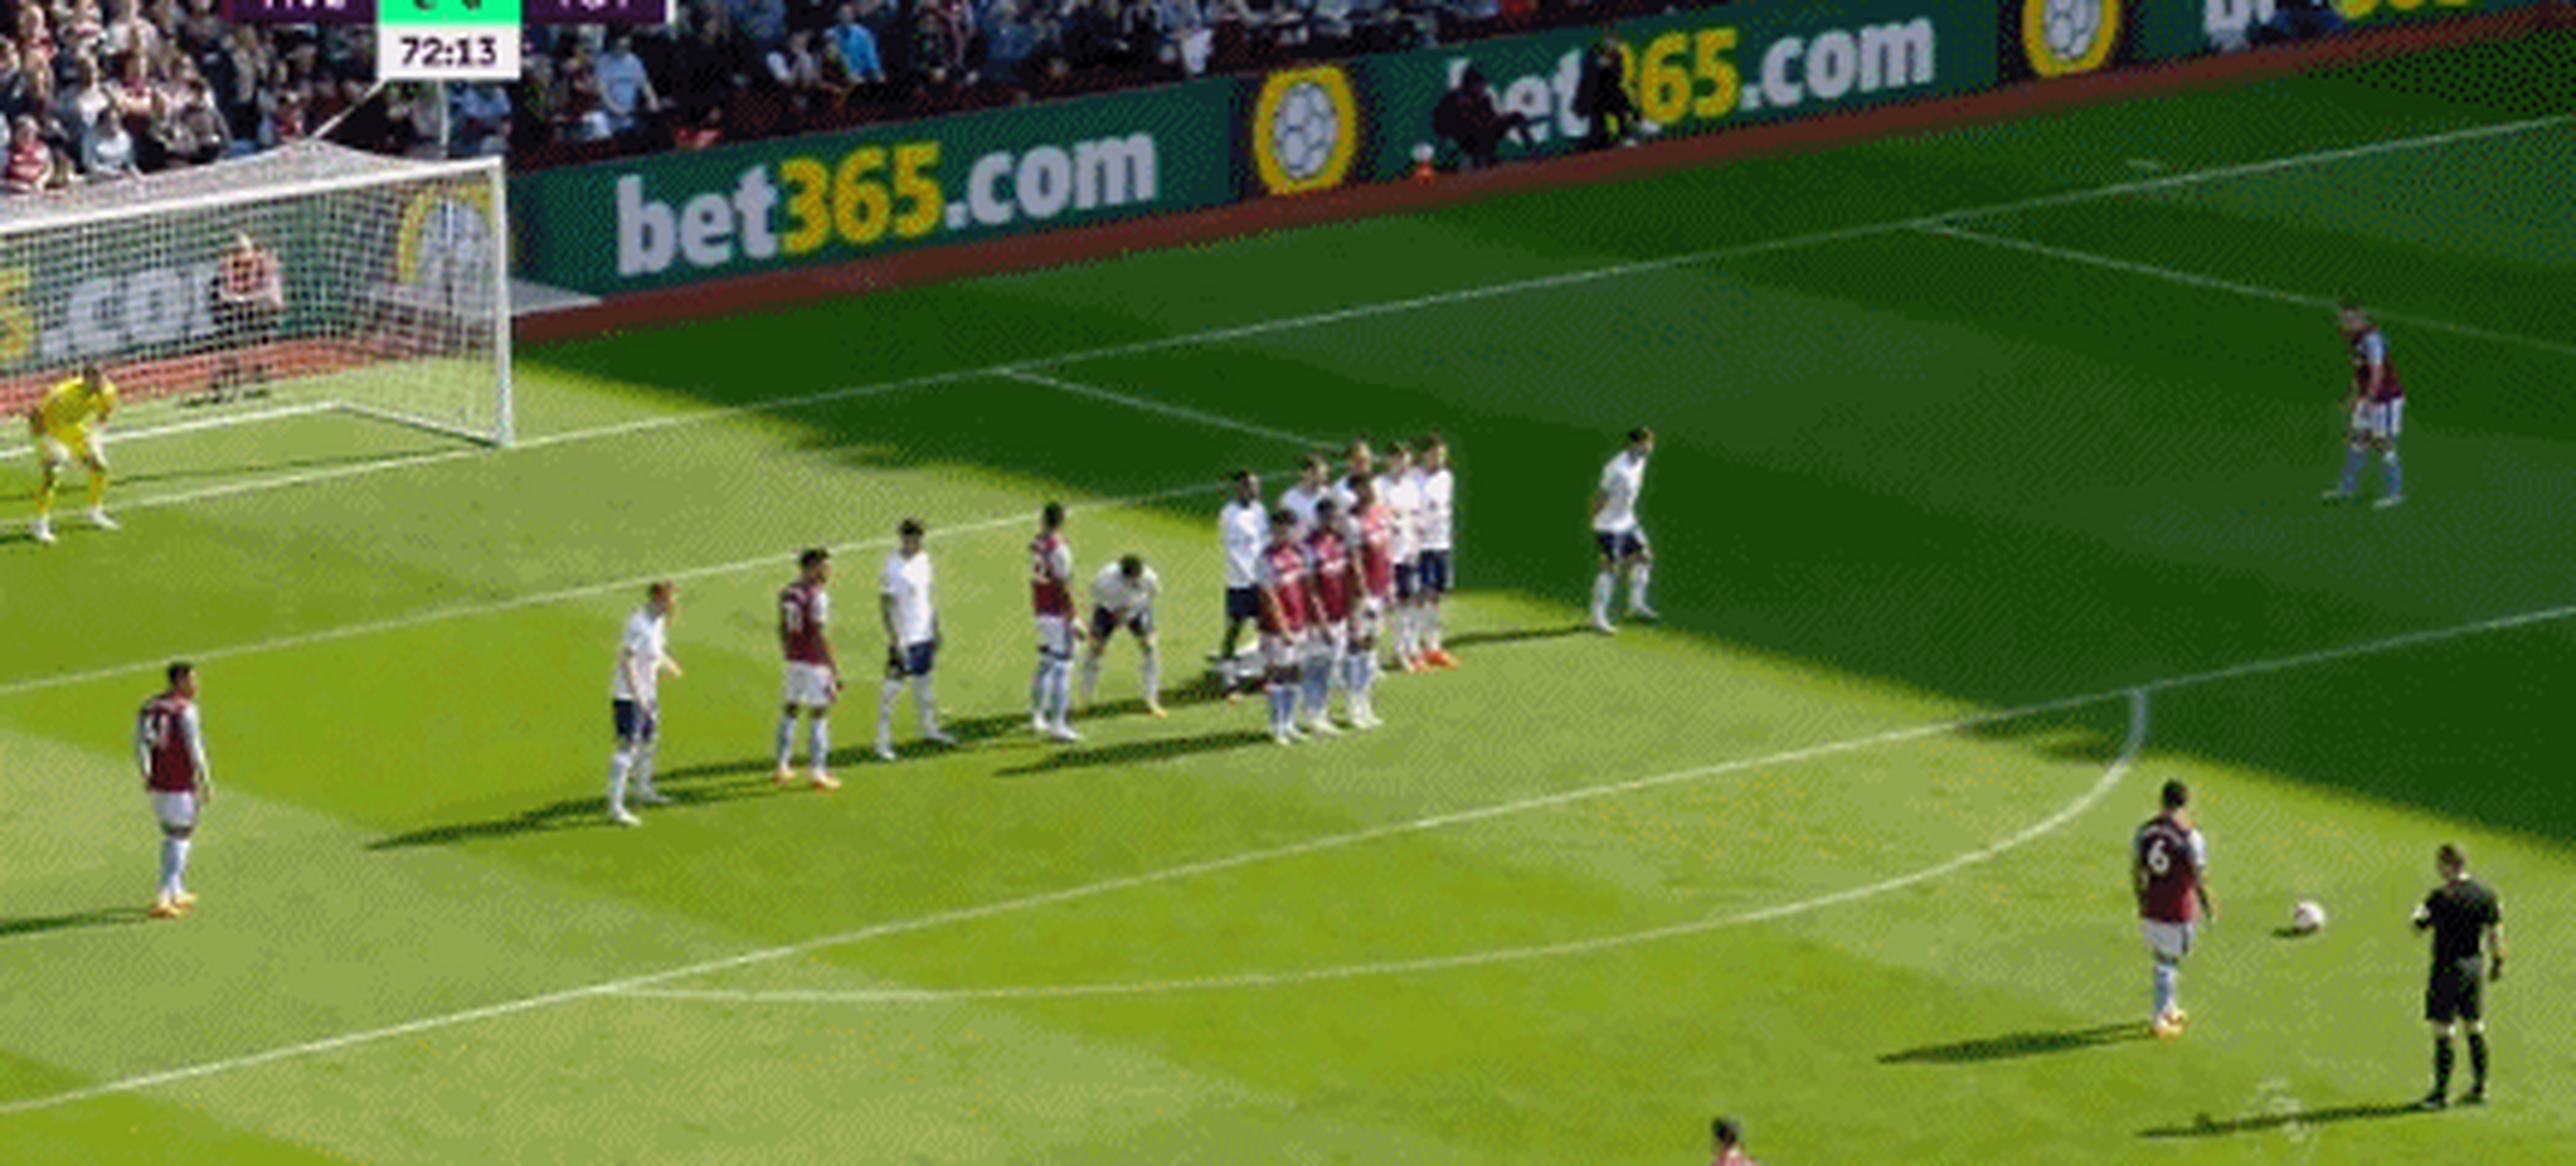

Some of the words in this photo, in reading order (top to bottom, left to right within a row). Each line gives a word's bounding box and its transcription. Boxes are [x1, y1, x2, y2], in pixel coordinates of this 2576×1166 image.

[1446, 17, 1935, 143] et65.com
[616, 131, 1157, 277] bet365.com
[2148, 838, 2170, 873] 6
